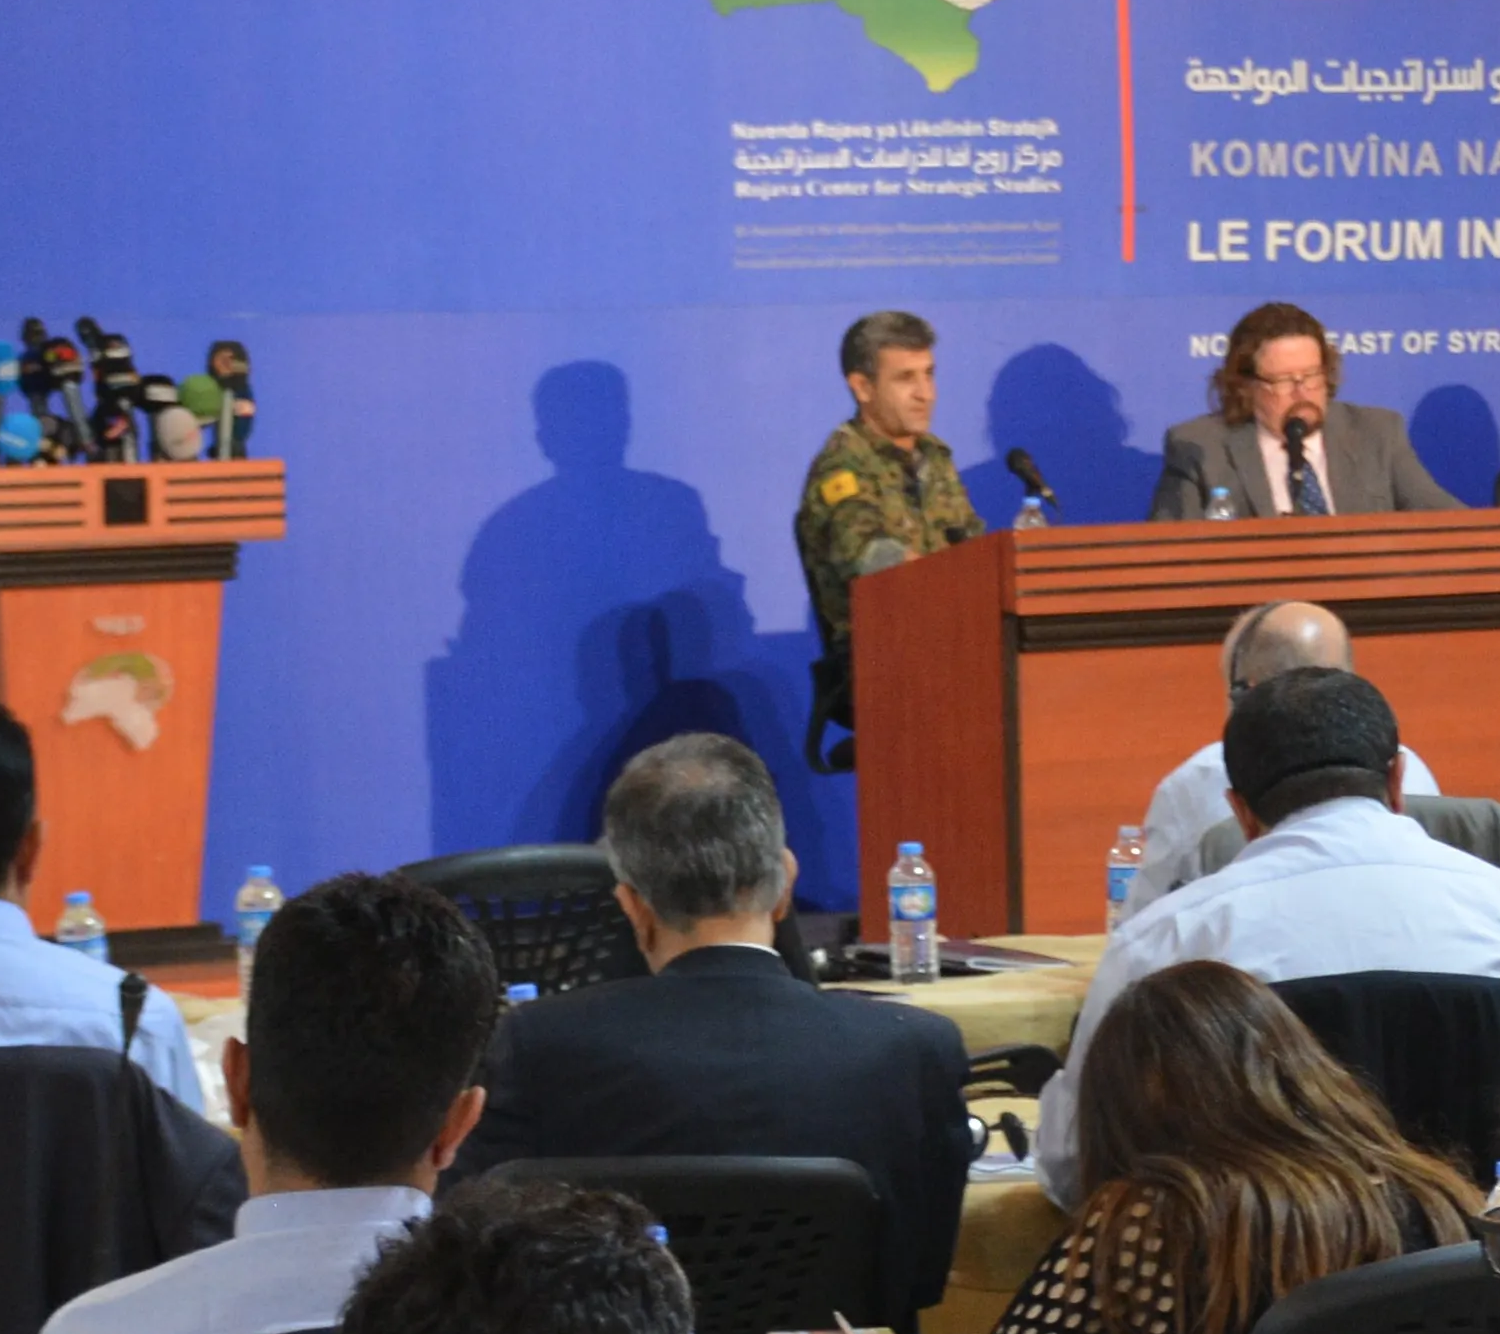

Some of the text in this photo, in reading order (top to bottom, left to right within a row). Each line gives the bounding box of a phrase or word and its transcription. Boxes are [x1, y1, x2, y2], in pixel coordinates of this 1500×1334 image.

[1185, 57, 1308, 105] المواجهة
[1190, 132, 1444, 178] KOMCIVÎNA
[1187, 220, 1250, 262] LE
[1265, 219, 1443, 263] FORUM
[1402, 330, 1437, 354] OF
